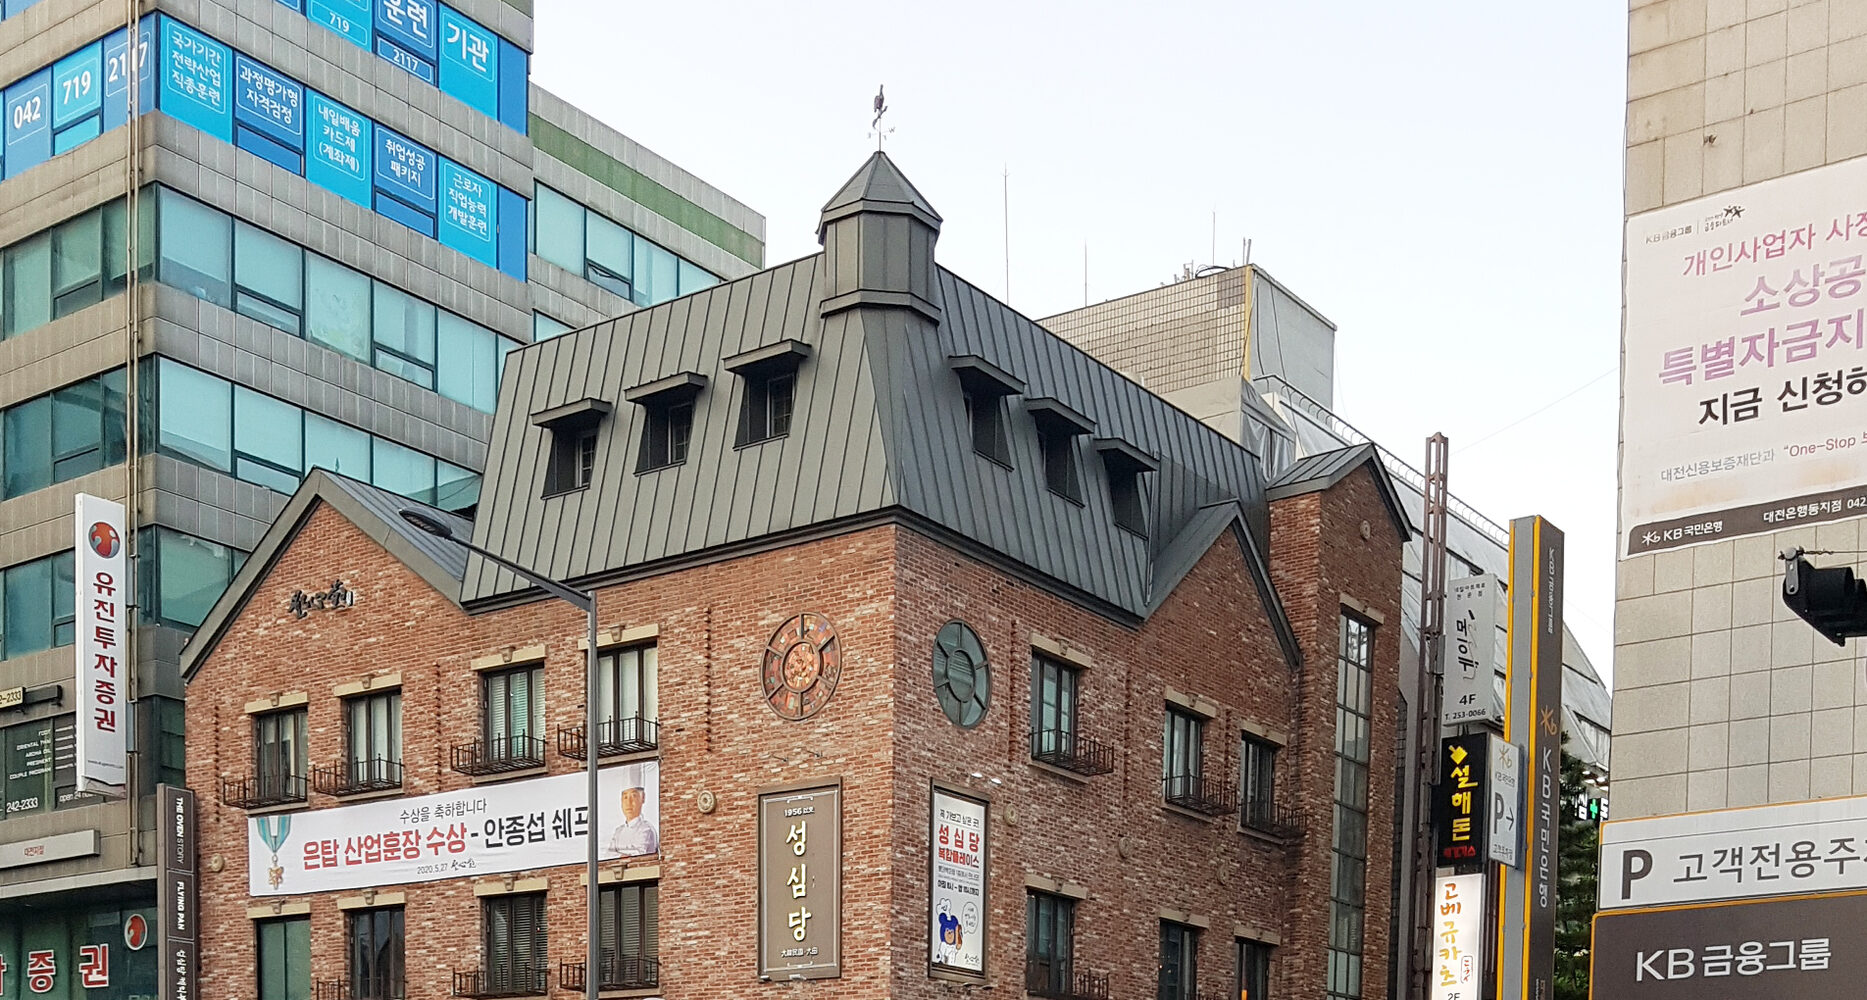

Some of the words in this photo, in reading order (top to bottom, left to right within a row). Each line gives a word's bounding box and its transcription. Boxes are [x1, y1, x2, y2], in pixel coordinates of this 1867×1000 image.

[171, 30, 222, 63] 국가기간
[329, 12, 350, 32] 719
[393, 49, 419, 71] 2117
[447, 22, 489, 72] 기관
[171, 49, 222, 87] 전략산업
[13, 96, 41, 129] 042
[62, 71, 91, 104] 719
[171, 69, 221, 107] 직종훈련
[246, 88, 292, 124] 자격검정
[318, 100, 361, 137] 내일배움
[322, 124, 356, 153] 카드제
[385, 138, 426, 171] 취업성공
[319, 142, 360, 173] (계좌제)
[390, 161, 422, 188] 패키지
[448, 187, 487, 218] 직업능력
[452, 172, 483, 199] 근로자
[448, 204, 487, 236] 개발훈련
[1683, 223, 1816, 276] 개인사업자
[1740, 254, 1866, 316] 소상공
[1658, 308, 1865, 386] 특별자금지
[1698, 387, 1763, 426] 지금
[1661, 448, 1775, 482] 대전신용보증재단과
[1663, 519, 1723, 542] KB국민은행
[1764, 500, 1842, 524] 대전은행동지점
[92, 570, 119, 734] 유진투자증권
[1452, 708, 1487, 720] 253-0066
[1459, 694, 1476, 706] 4F
[6, 797, 38, 813] 242-2333
[399, 806, 430, 824] 수상을
[434, 798, 488, 820] 축하합니다
[784, 807, 802, 818] 1956
[1493, 792, 1504, 834] P
[303, 838, 341, 870] 은탑
[344, 828, 422, 866] 산업훈장
[426, 822, 467, 856] 수상
[484, 811, 546, 849] 안종섭
[938, 823, 980, 853] 성심당
[1539, 747, 1551, 909] KB국민은행
[177, 838, 185, 864] STORY
[1621, 849, 1653, 900] P
[1673, 837, 1867, 884] 고객전용주
[177, 881, 185, 911] FLYING
[785, 820, 812, 942] 성심당
[1440, 882, 1463, 987] 고베규카츠
[1635, 937, 1832, 983] KB금융그룹
